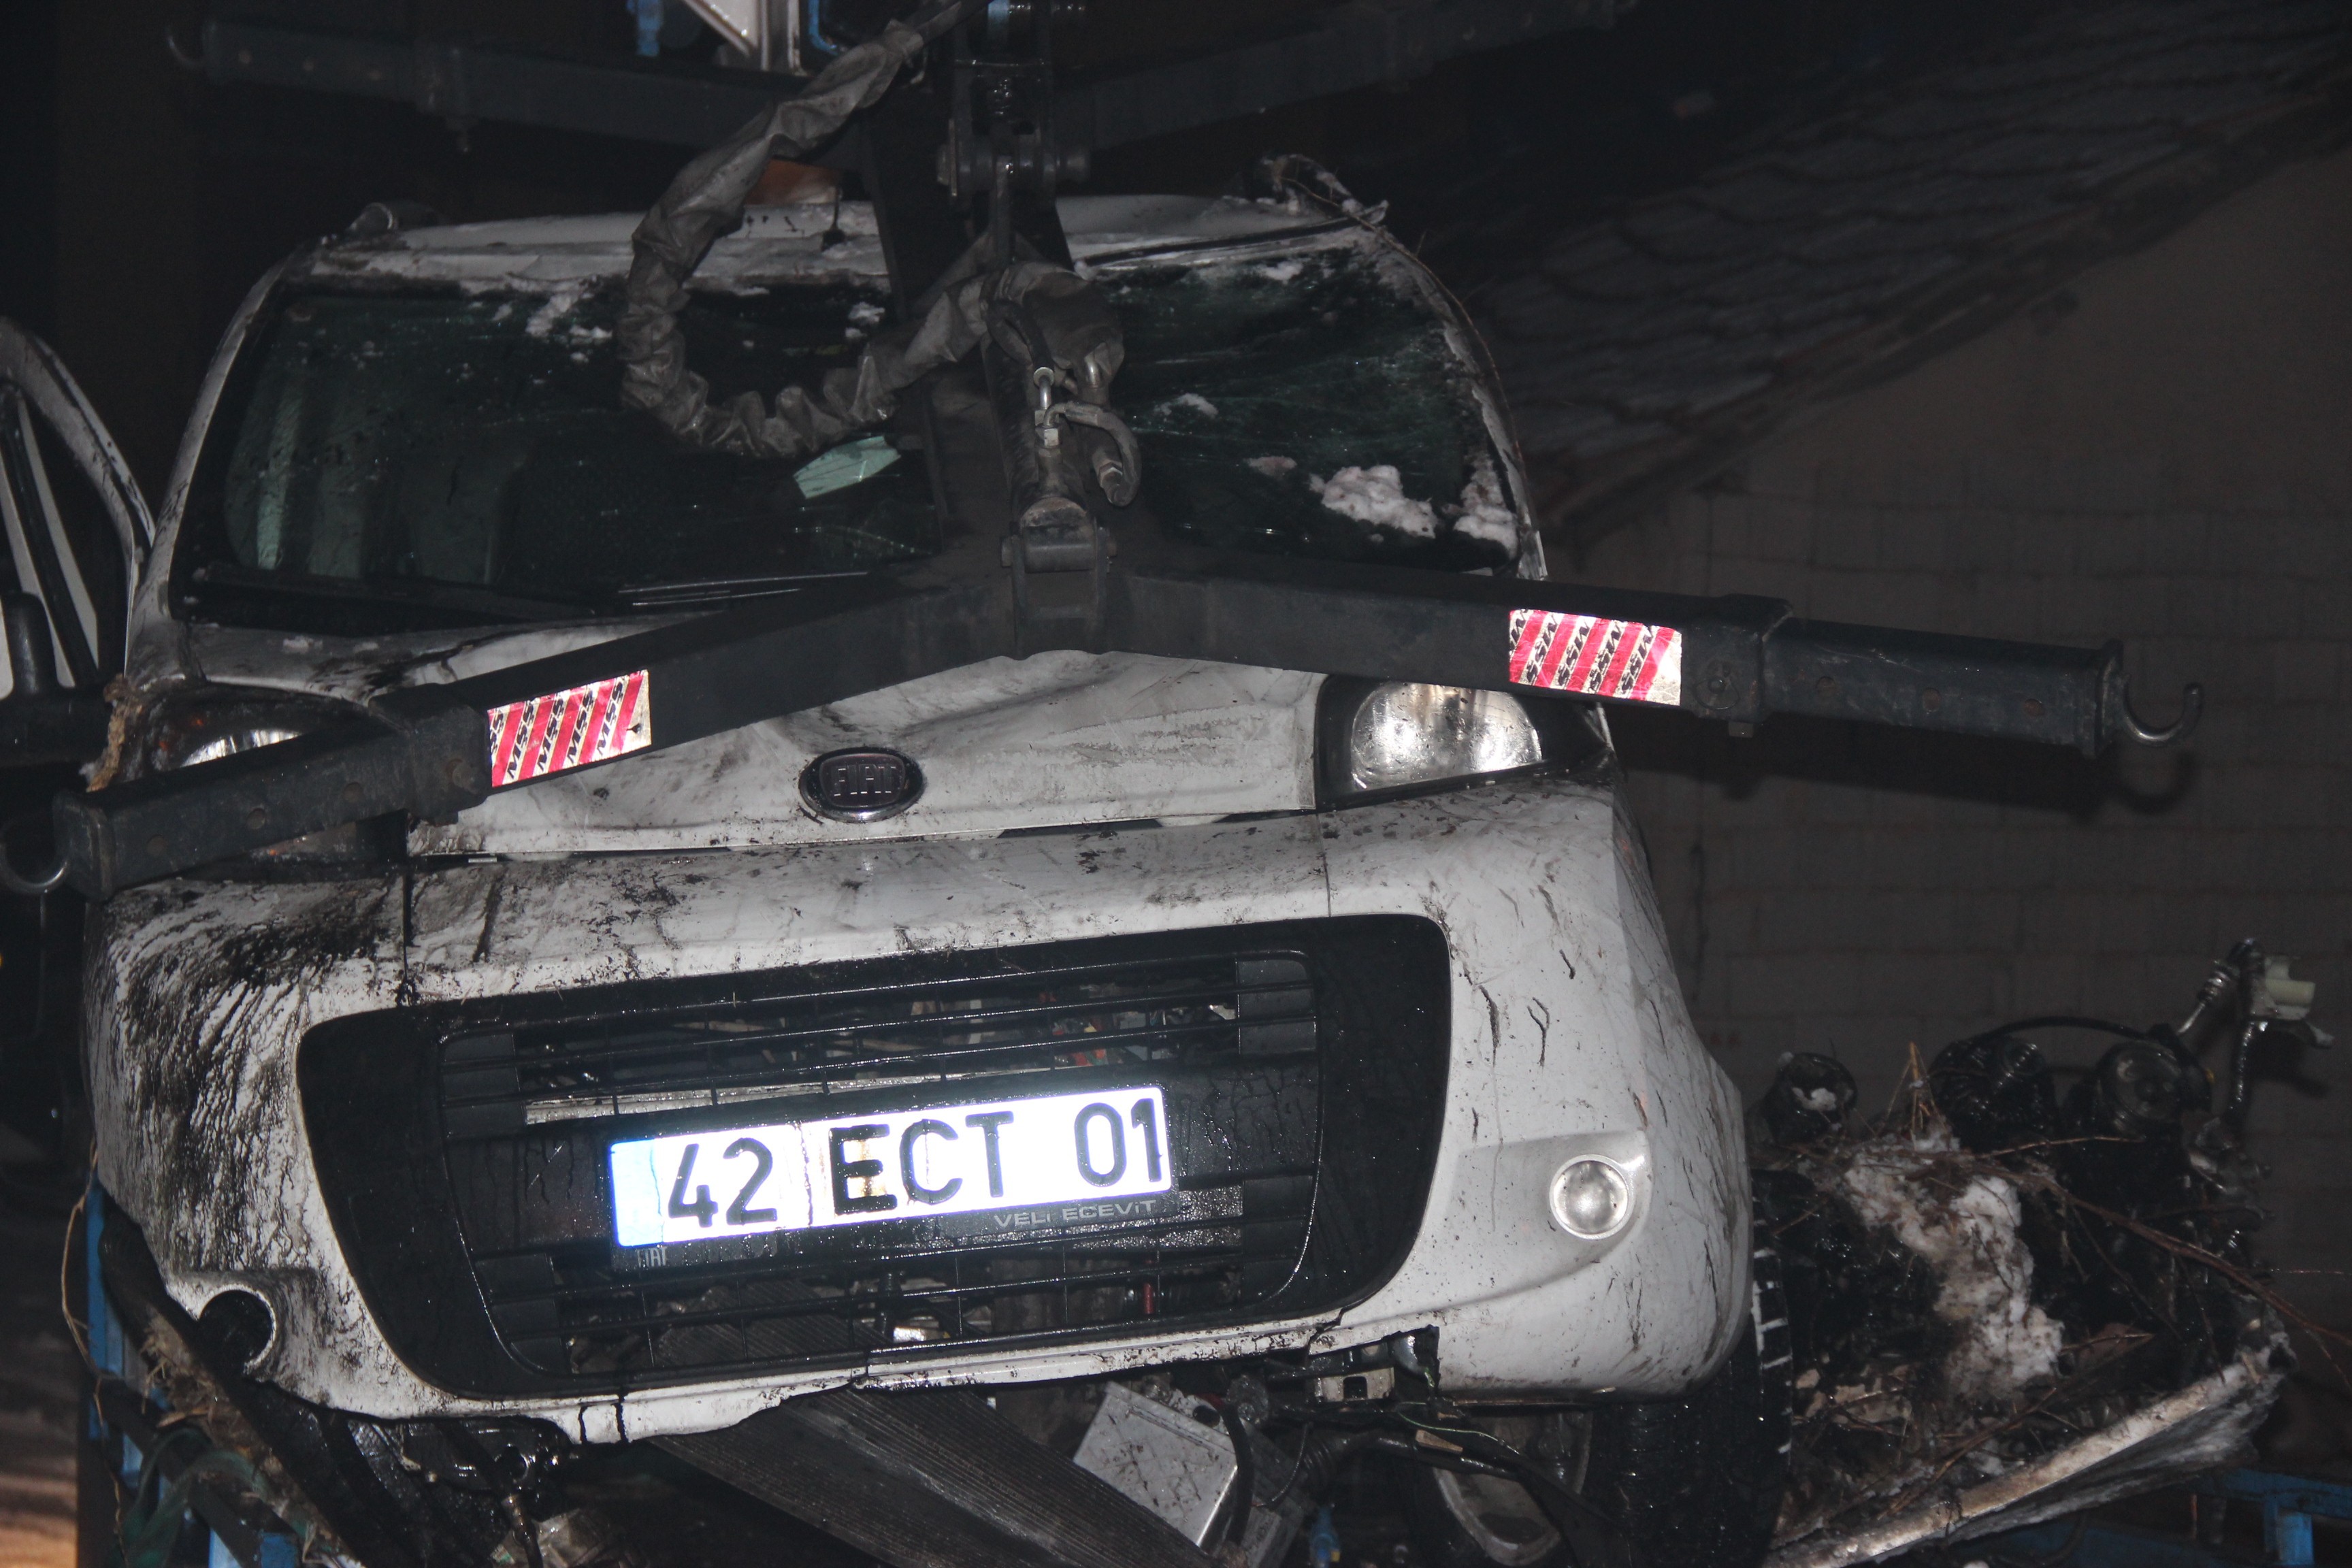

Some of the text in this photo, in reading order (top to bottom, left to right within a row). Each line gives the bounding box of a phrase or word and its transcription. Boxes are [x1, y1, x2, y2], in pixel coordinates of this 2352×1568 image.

[668, 1097, 1163, 1228] 42 ECT 01
[636, 1246, 668, 1268] FIAT
